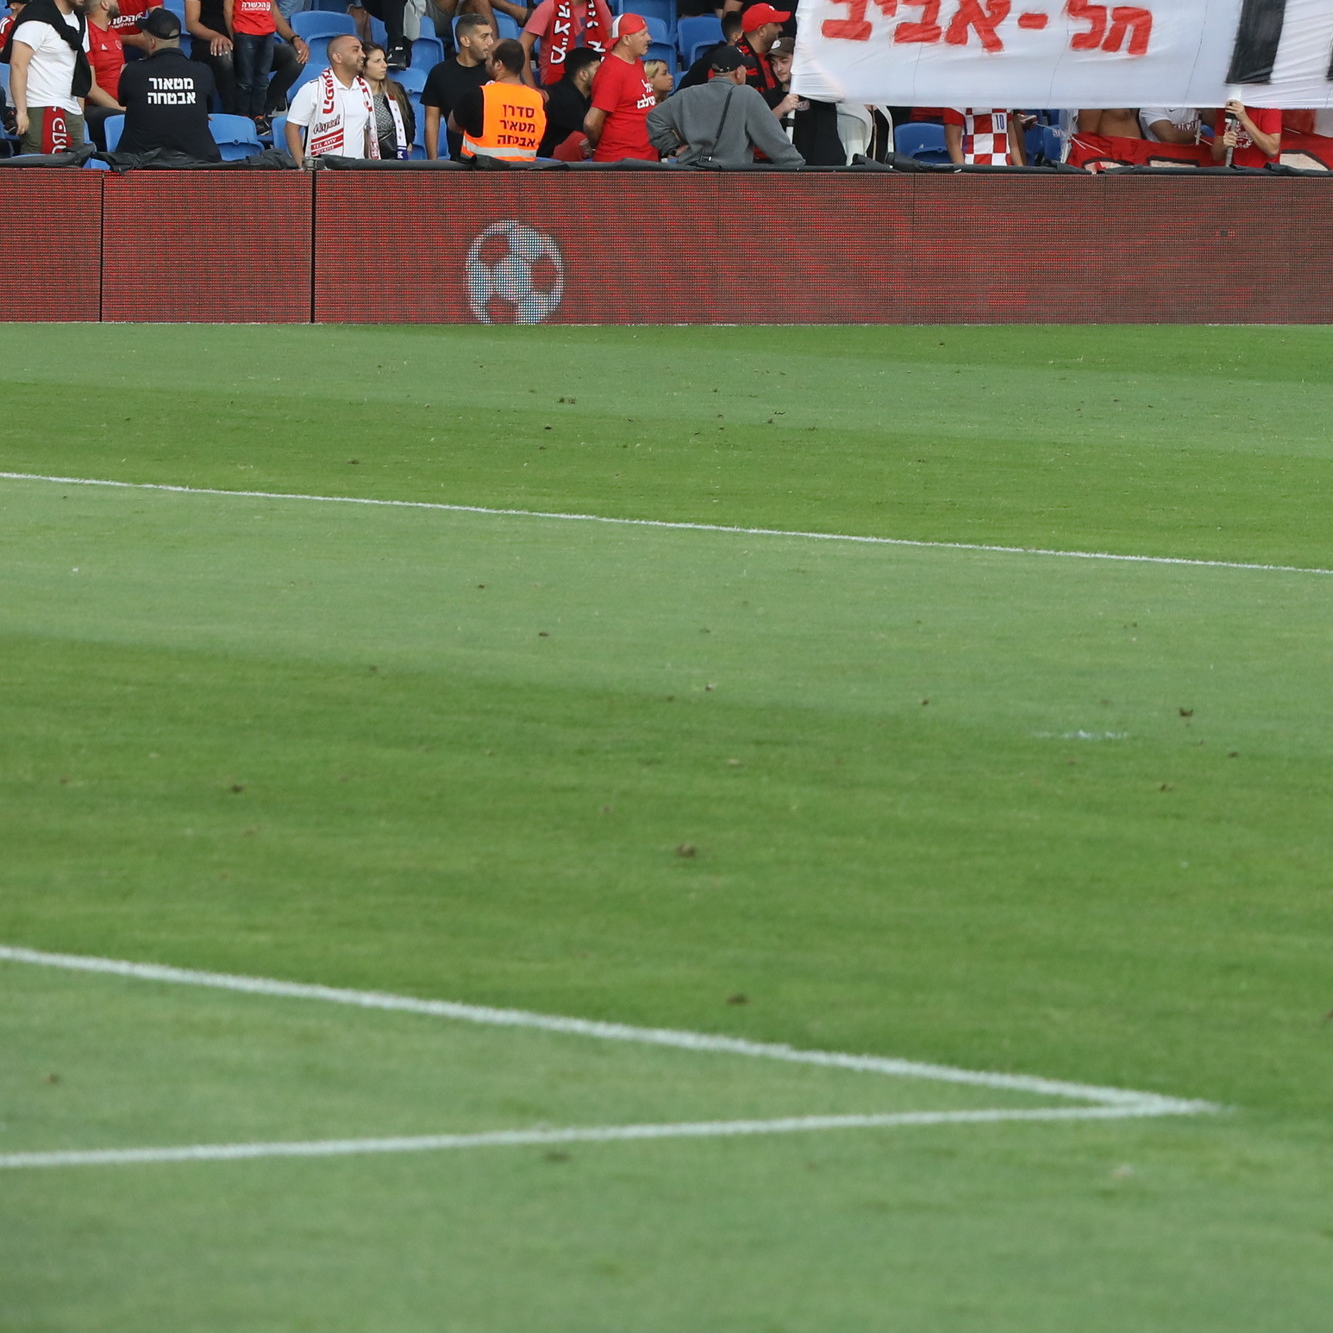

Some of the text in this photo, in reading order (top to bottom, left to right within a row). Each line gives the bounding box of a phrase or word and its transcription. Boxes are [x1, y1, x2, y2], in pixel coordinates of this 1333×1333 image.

[148, 77, 194, 91] מטאור
[147, 91, 196, 105] אבטחה
[502, 104, 535, 118] סדרן
